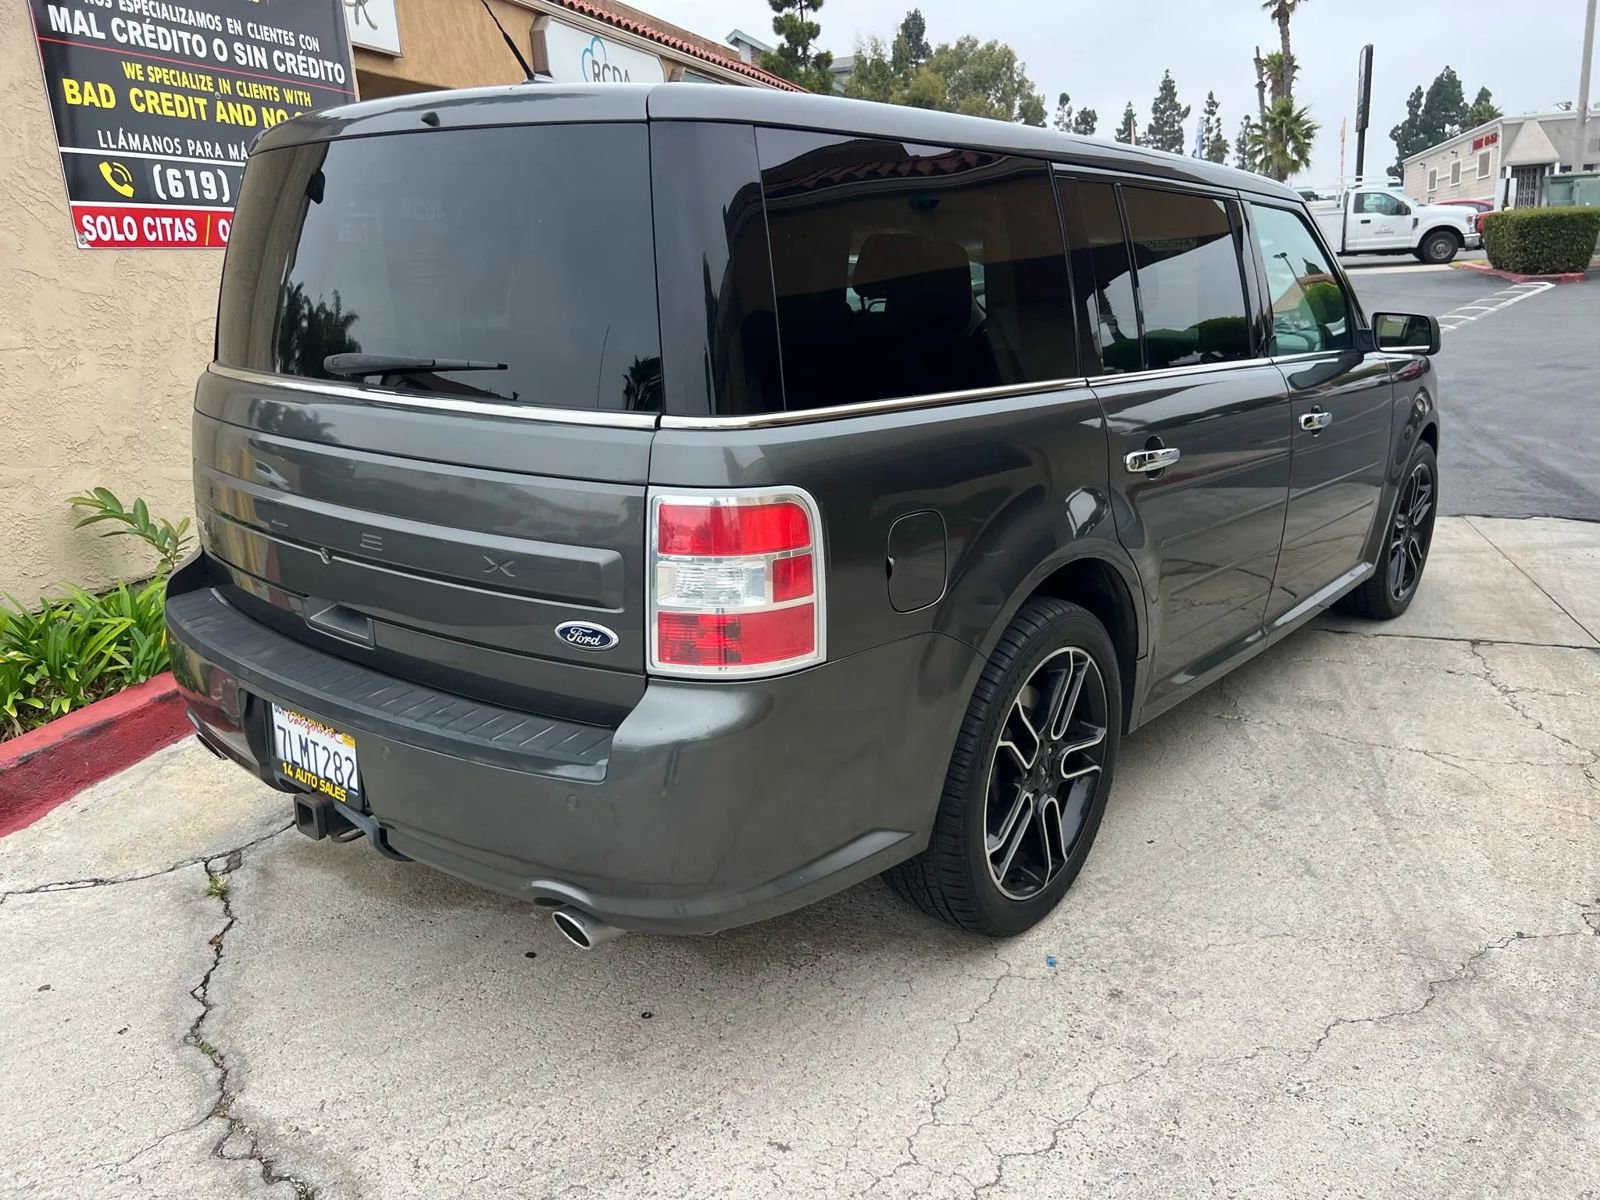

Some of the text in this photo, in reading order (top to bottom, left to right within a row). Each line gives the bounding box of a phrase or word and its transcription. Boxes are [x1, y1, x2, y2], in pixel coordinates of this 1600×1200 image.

[48, 4, 345, 85] MAL CRÉDITO O SIN CRÉDITO
[118, 0, 222, 31] ESPECIALIZAMOS
[226, 17, 243, 36] EN
[247, 22, 295, 46] CLIENTES
[300, 34, 319, 53] CON
[62, 78, 116, 109] BAD
[129, 87, 208, 121] CREDIT
[216, 100, 257, 127] AND
[122, 61, 312, 107] WE SPECIALIZE IN CLIENTS WITH
[97, 127, 182, 155] LLÁMANOS
[187, 139, 224, 159] PARA
[153, 164, 230, 203] (619)
[82, 215, 138, 242] SOLO
[143, 216, 198, 242] CITAS
[566, 626, 602, 646] Ford
[277, 724, 359, 793] 7LMT282
[282, 761, 347, 802] 14 AUTO SALES
